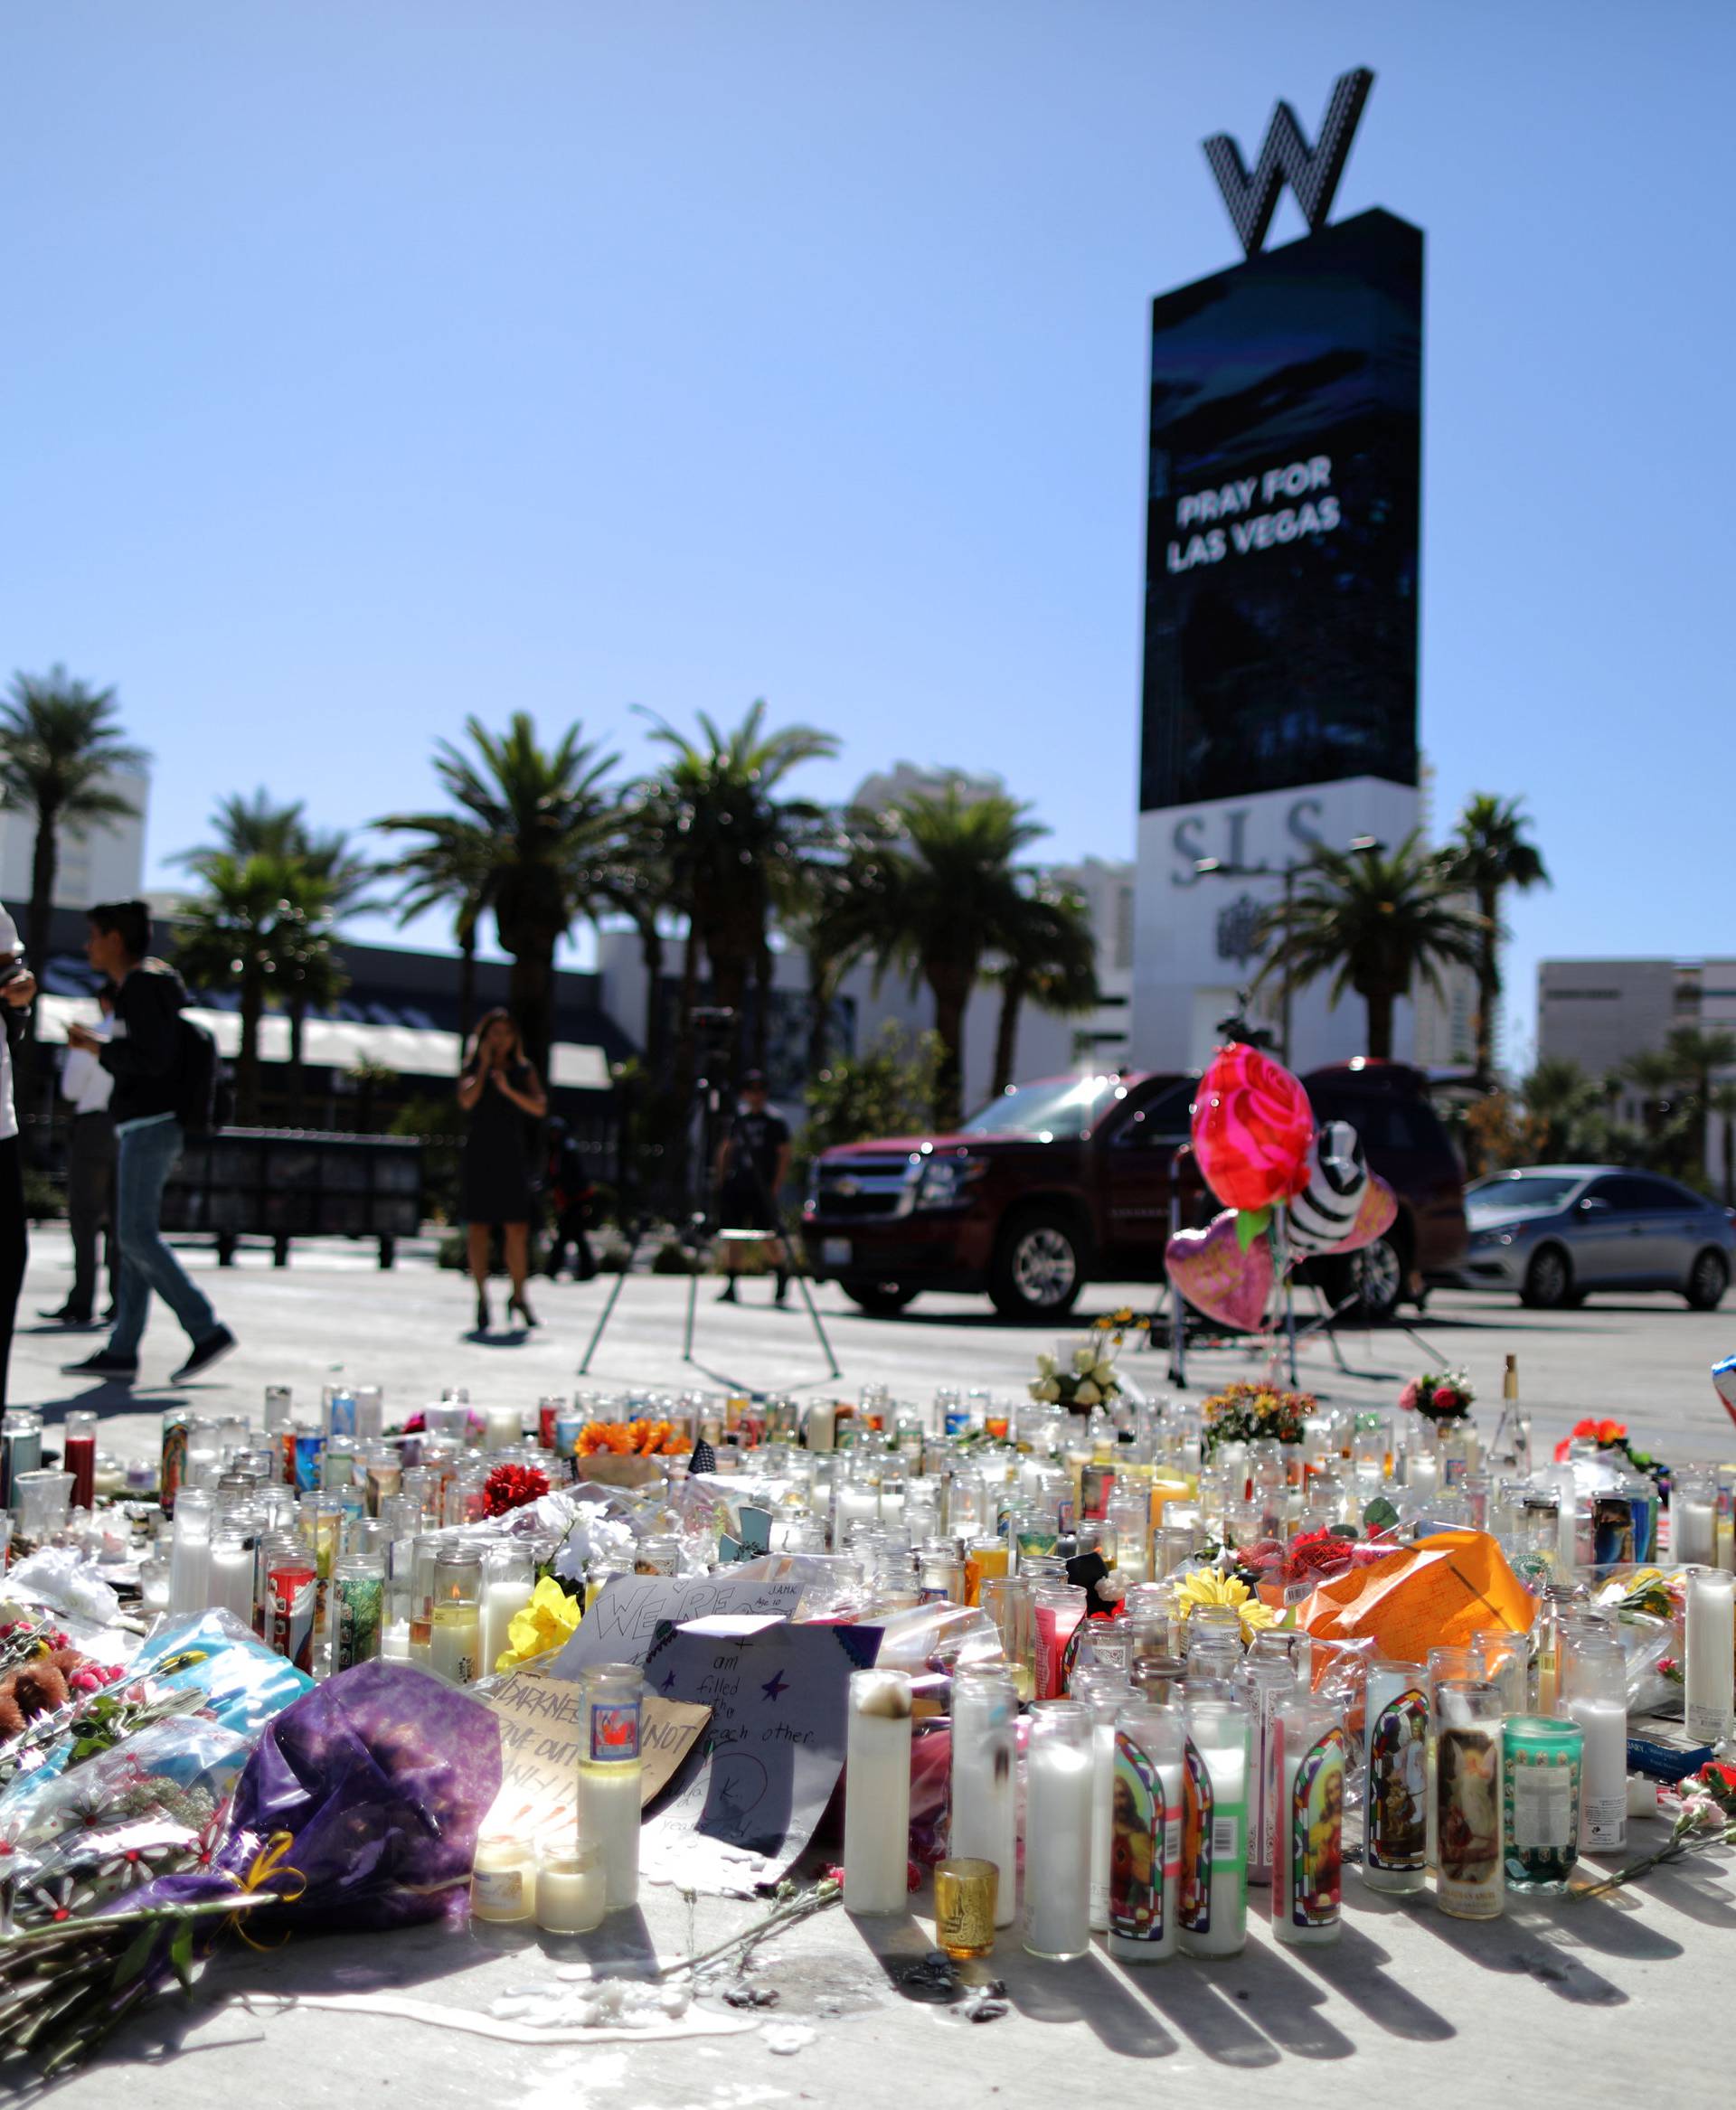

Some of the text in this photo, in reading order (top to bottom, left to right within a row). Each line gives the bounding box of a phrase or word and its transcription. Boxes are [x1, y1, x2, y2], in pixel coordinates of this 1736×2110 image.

[1203, 67, 1374, 257] W
[1176, 454, 1331, 530] PRAY FOR
[1166, 495, 1341, 574] LAS VEGAS
[696, 1675, 741, 1697] filled
